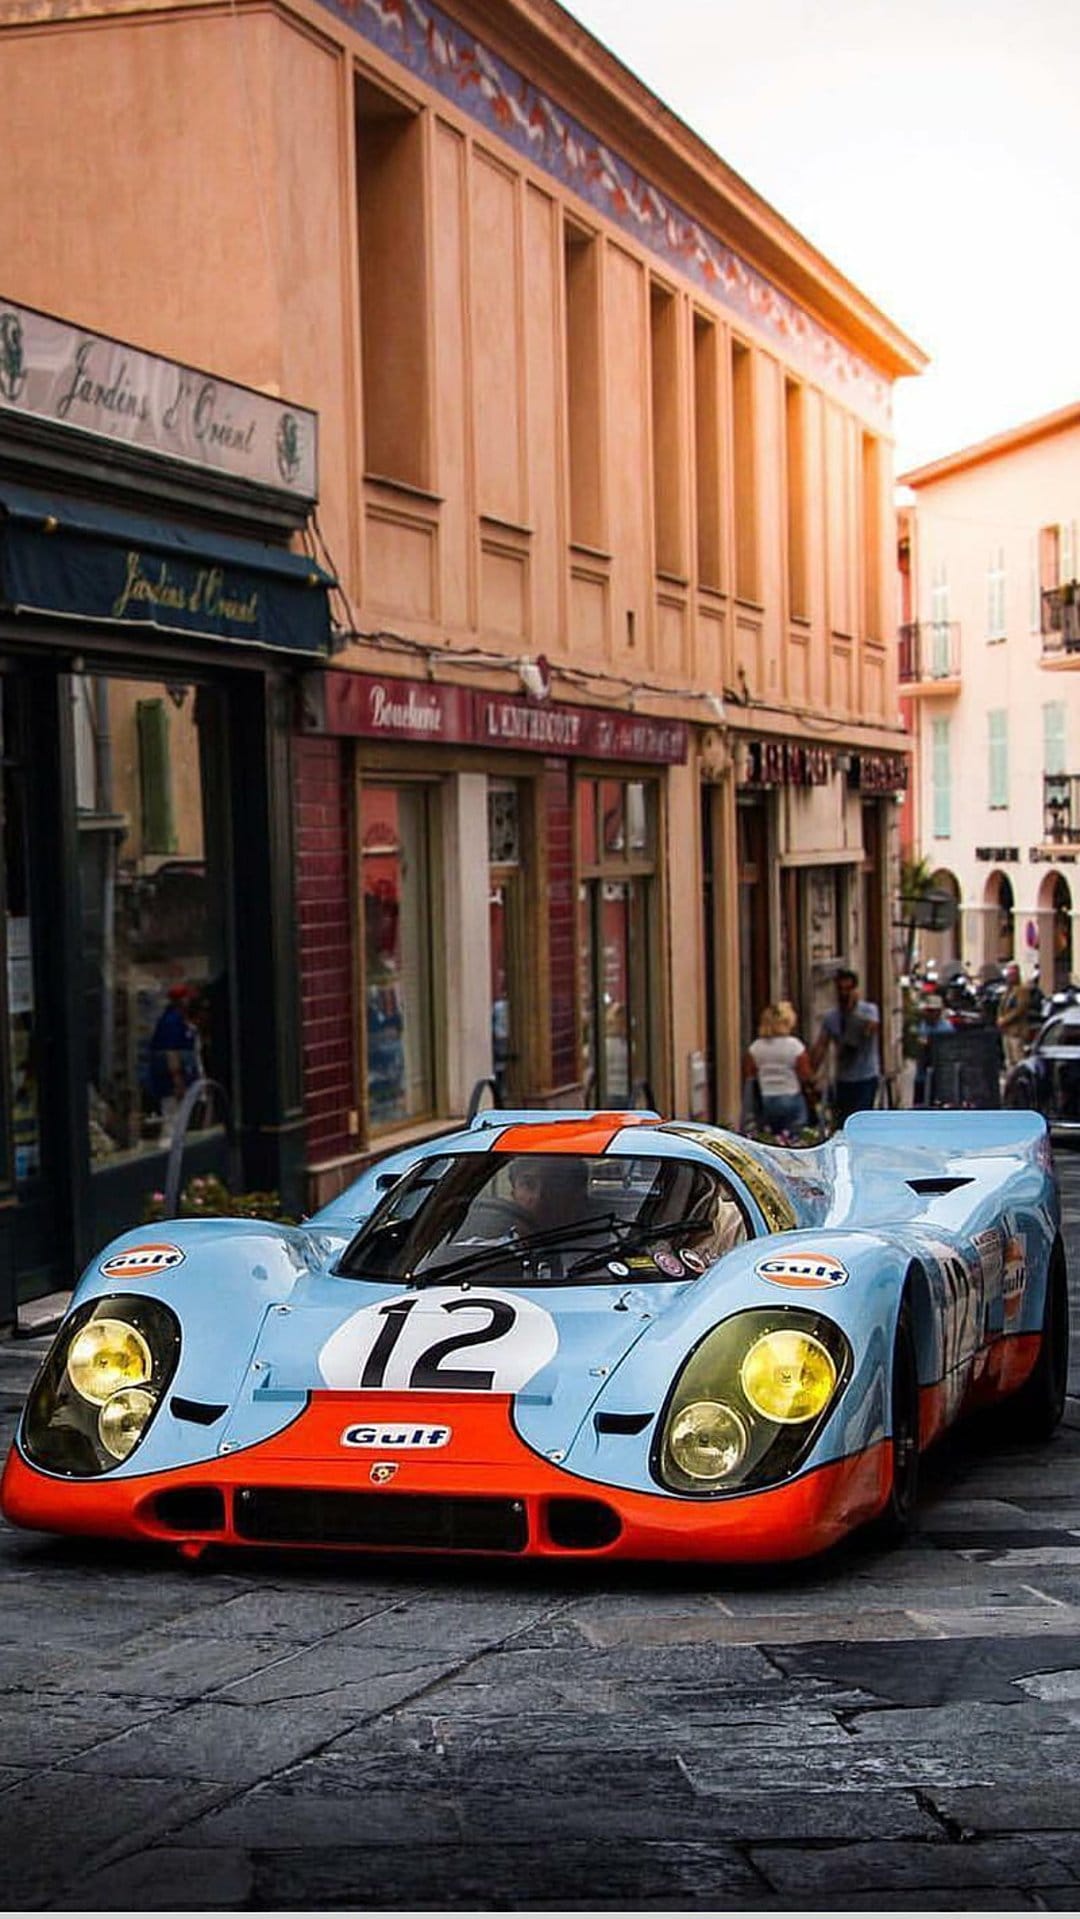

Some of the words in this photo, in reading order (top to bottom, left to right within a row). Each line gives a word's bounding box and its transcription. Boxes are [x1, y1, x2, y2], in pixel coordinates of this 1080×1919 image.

[57, 339, 147, 423] Jardins
[162, 380, 257, 453] d'Orient
[112, 551, 185, 617] Jardins
[104, 1252, 182, 1270] Gulf
[758, 1259, 847, 1283] Gulf
[359, 1298, 518, 1391] 12
[346, 1427, 449, 1447] Gulf
